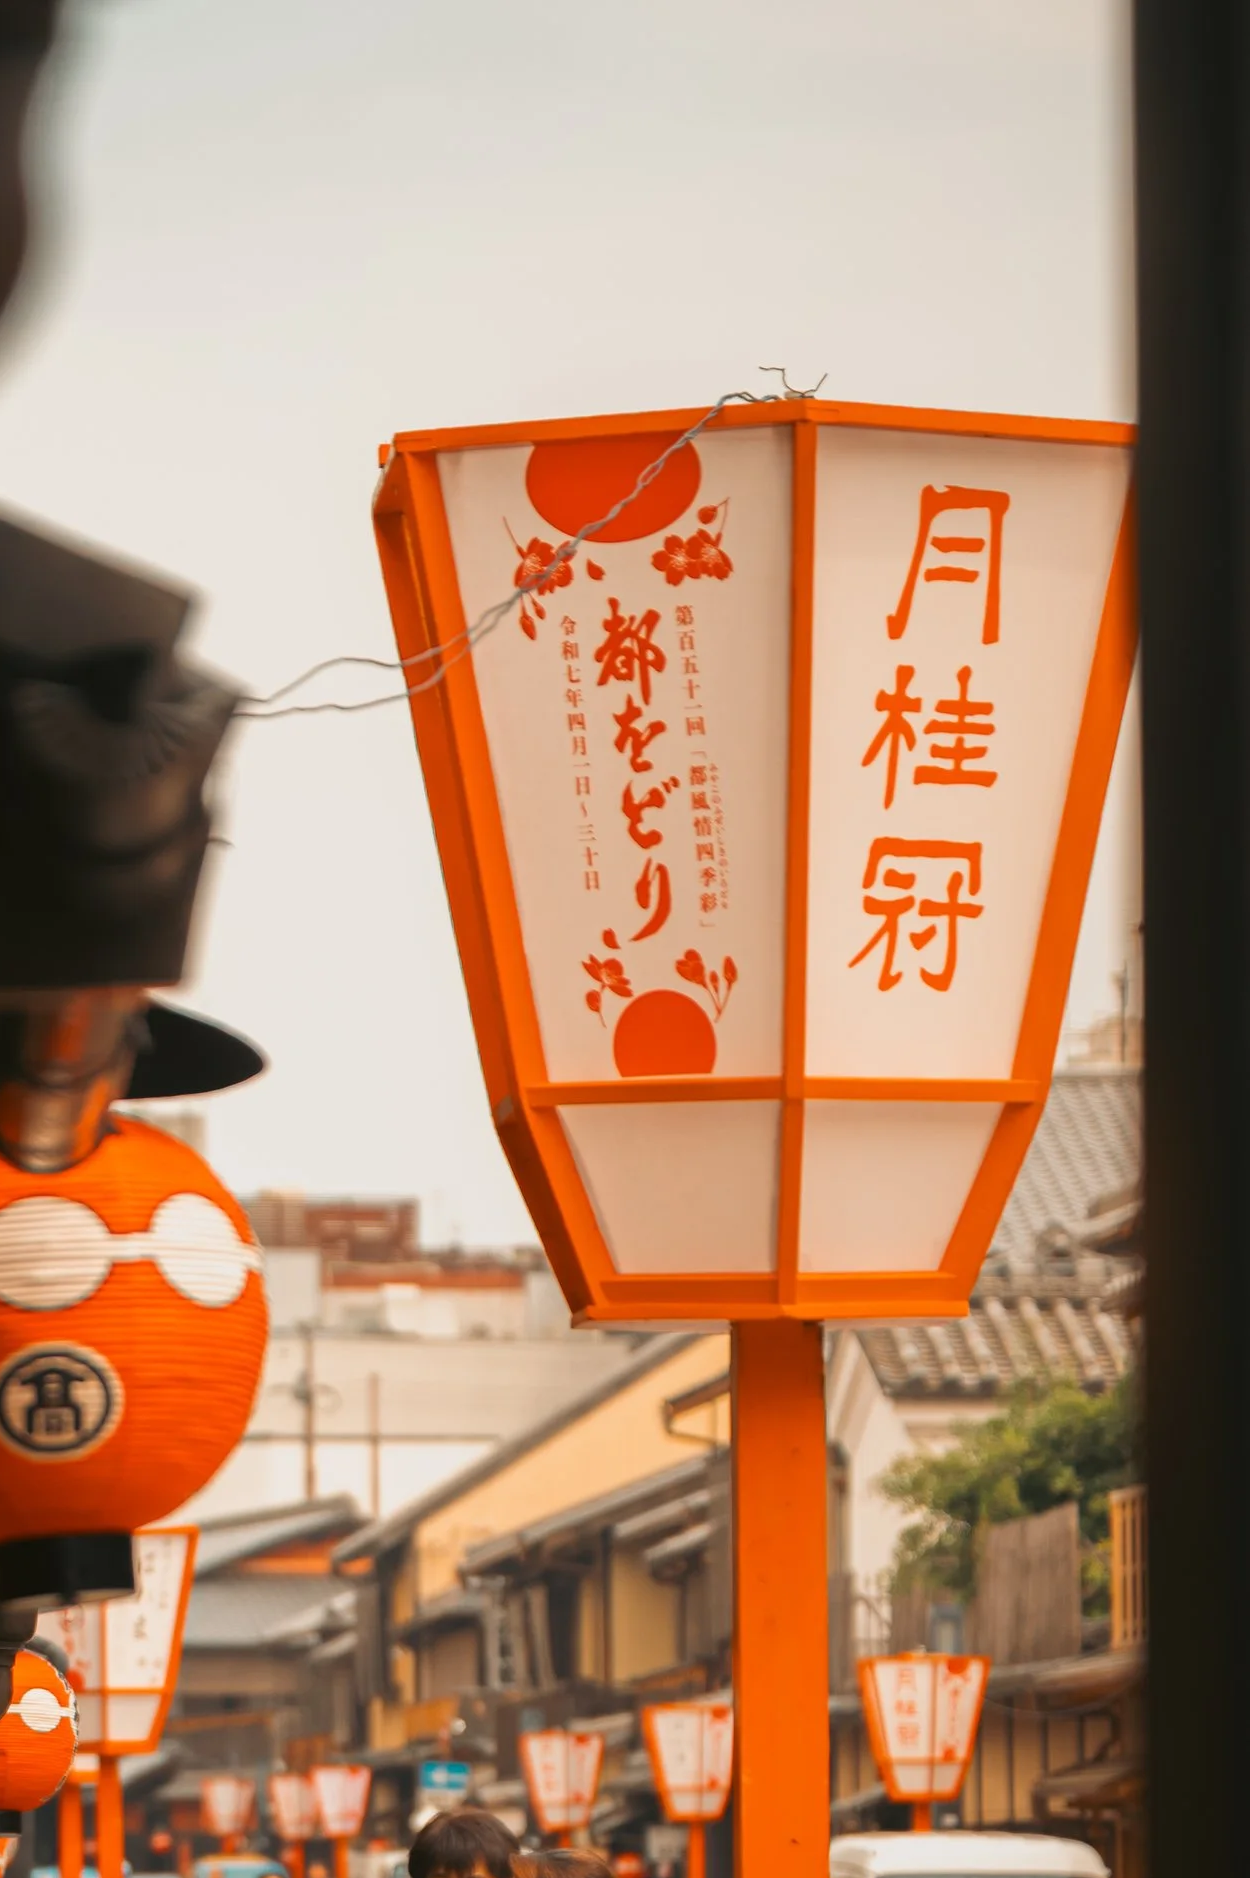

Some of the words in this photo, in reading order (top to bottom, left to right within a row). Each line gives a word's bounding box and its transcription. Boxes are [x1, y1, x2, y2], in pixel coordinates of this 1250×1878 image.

[594, 597, 680, 942] 都をどり
[848, 484, 1010, 992] 月桂冠
